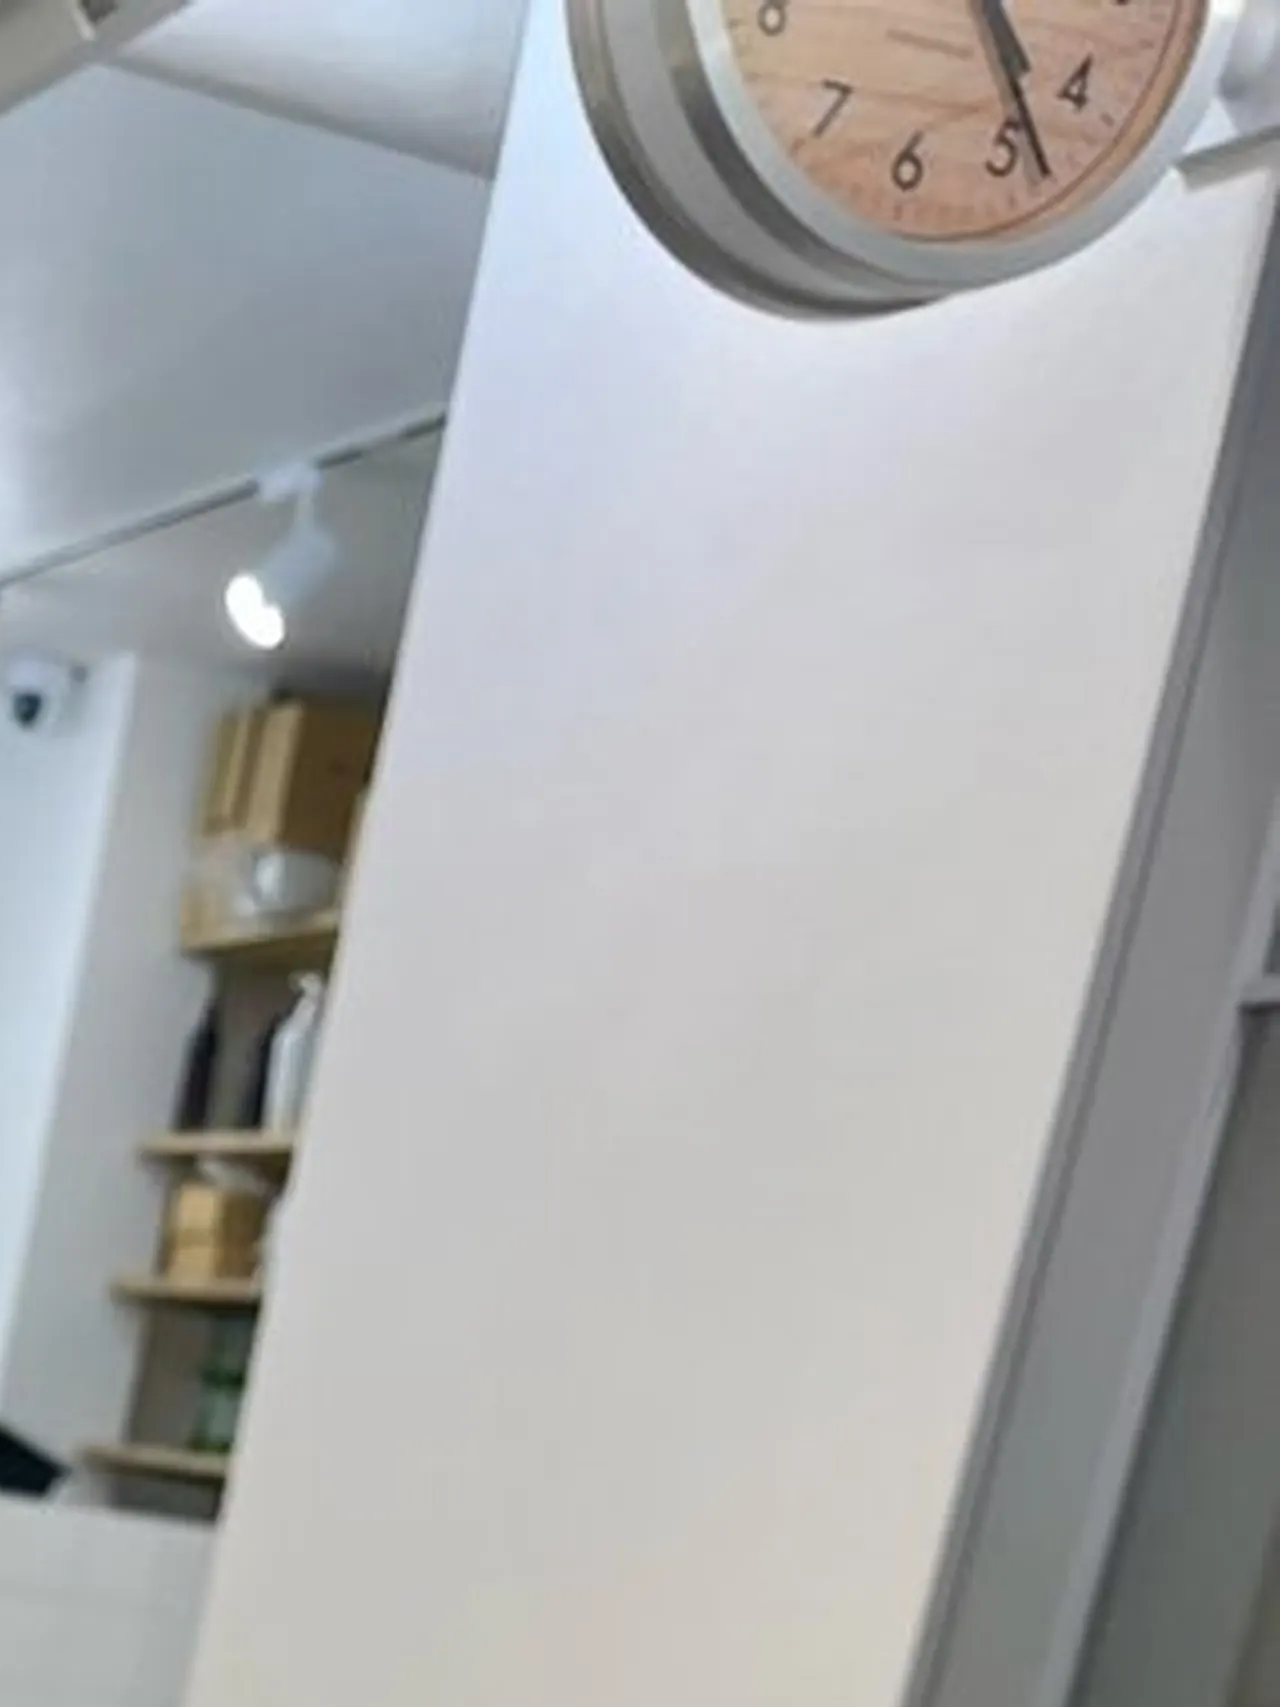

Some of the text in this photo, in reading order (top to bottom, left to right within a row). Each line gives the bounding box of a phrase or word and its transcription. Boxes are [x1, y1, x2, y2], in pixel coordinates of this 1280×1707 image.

[812, 77, 853, 138] 7
[1057, 53, 1093, 111] 4
[892, 130, 924, 192] 6
[985, 117, 1022, 177] 5
